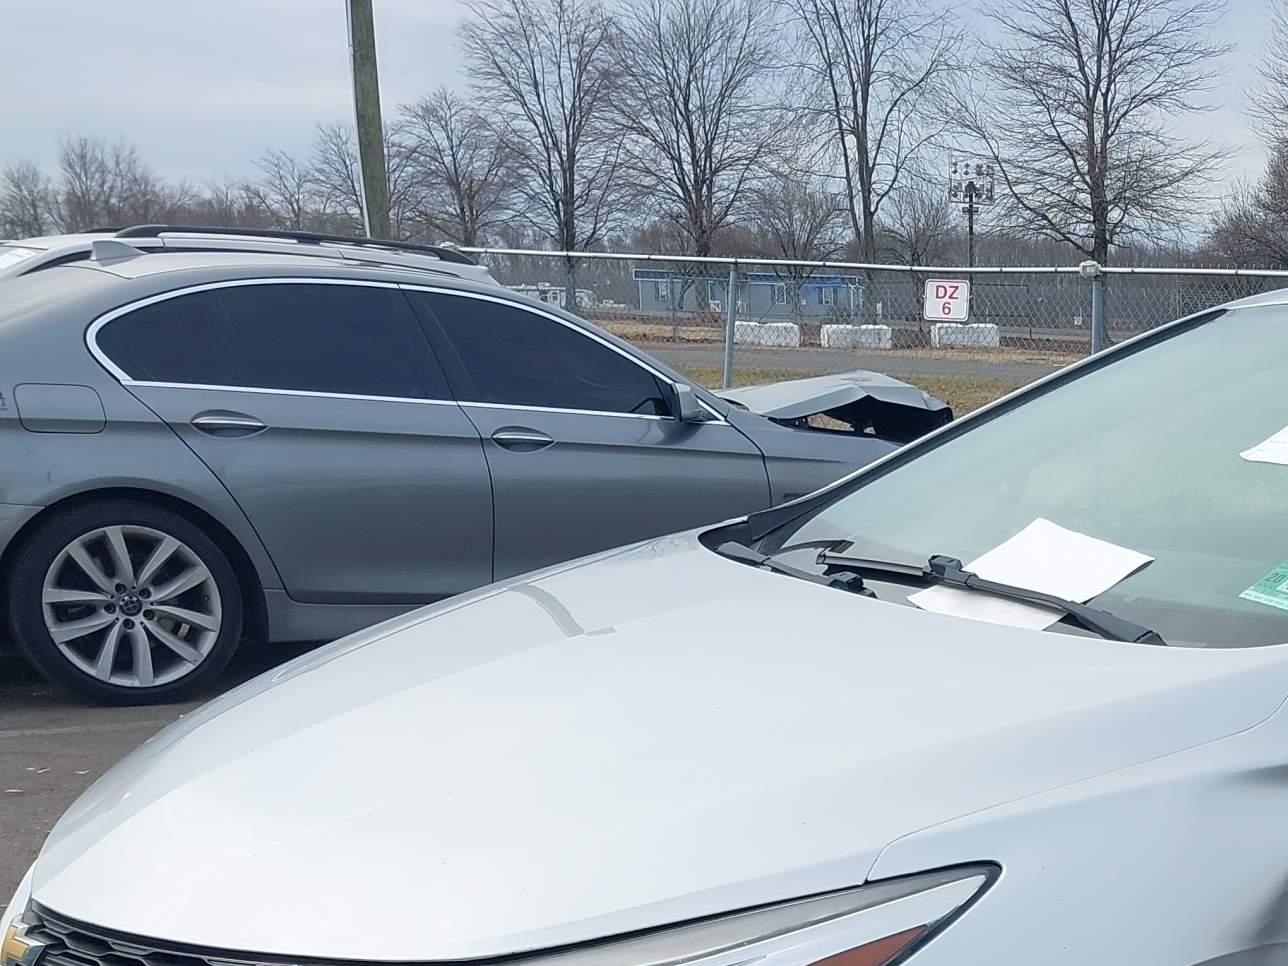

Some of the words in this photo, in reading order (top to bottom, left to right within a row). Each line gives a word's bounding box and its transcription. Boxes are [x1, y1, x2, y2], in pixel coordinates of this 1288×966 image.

[935, 285, 960, 300] DZ
[942, 301, 952, 316] 6
[1265, 572, 1286, 584] 20
